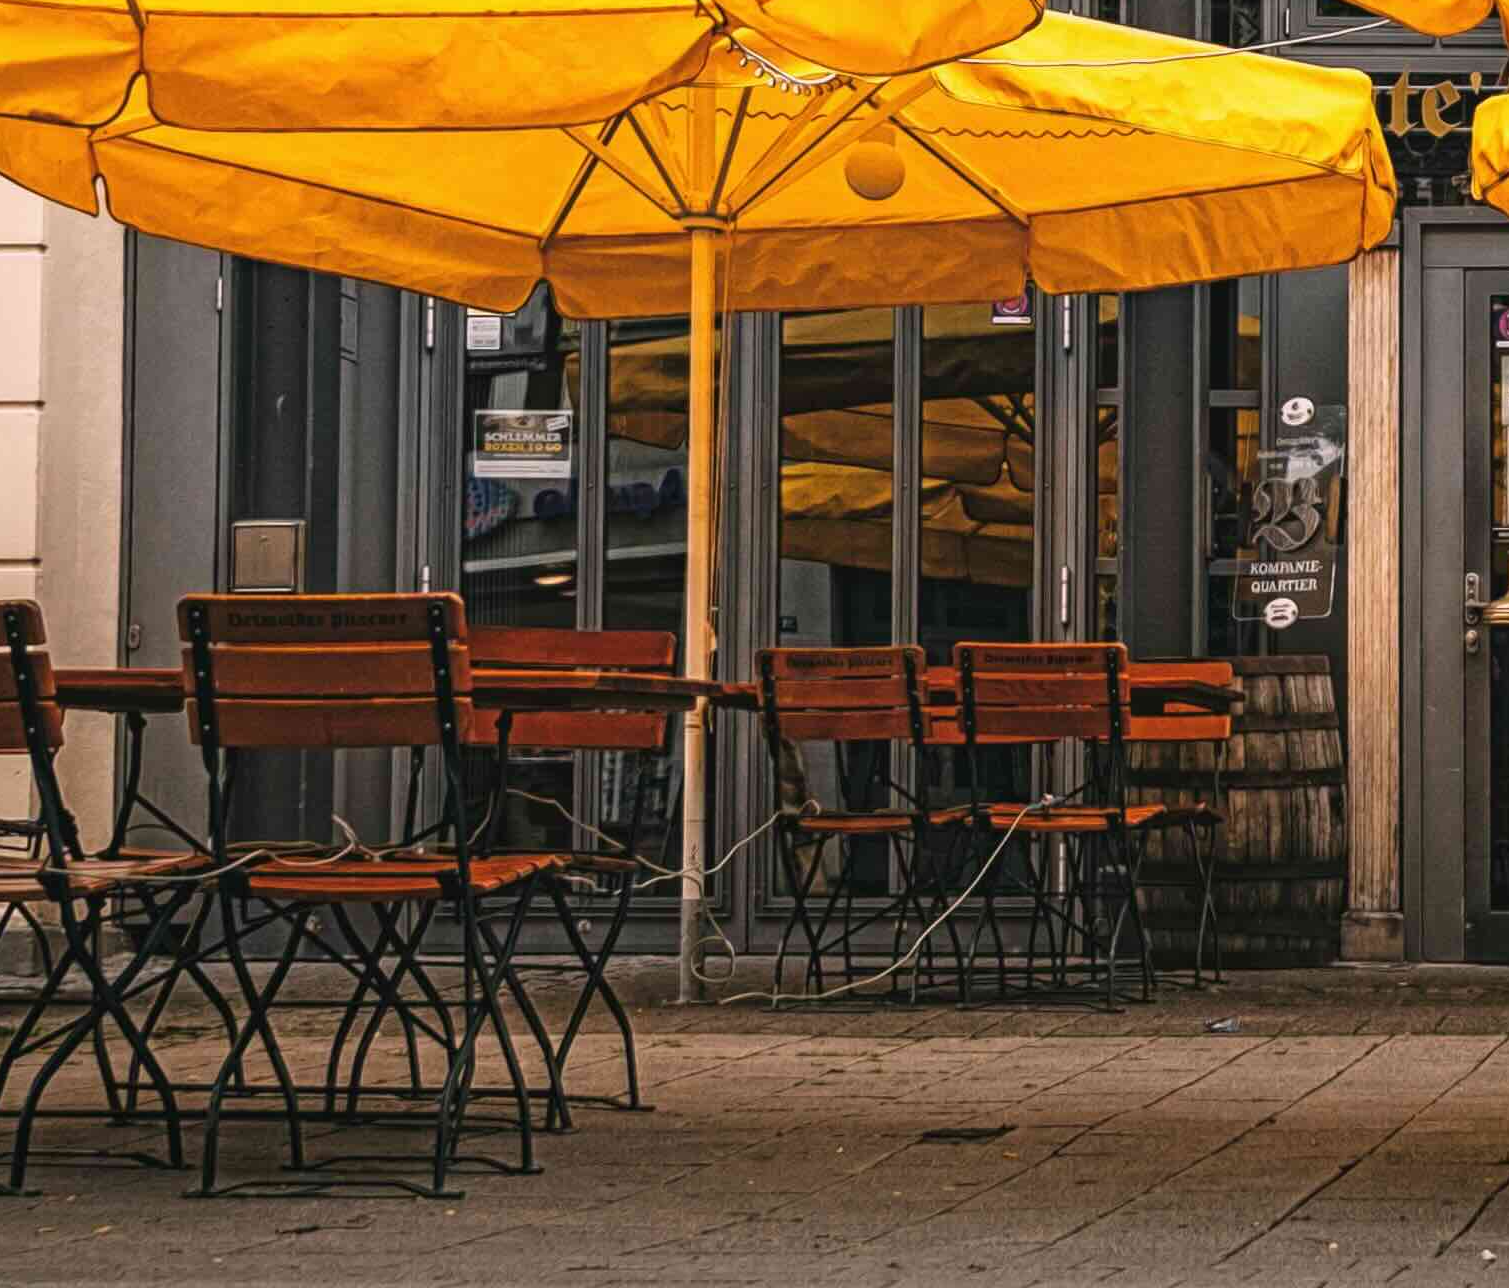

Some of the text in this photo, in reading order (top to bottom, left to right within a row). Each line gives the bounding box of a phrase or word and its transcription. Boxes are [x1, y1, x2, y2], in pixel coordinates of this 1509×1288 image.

[484, 432, 562, 442] SCHLEMMER
[1250, 560, 1323, 575] KOMPANIE-
[1251, 578, 1318, 593] QUARTIER
